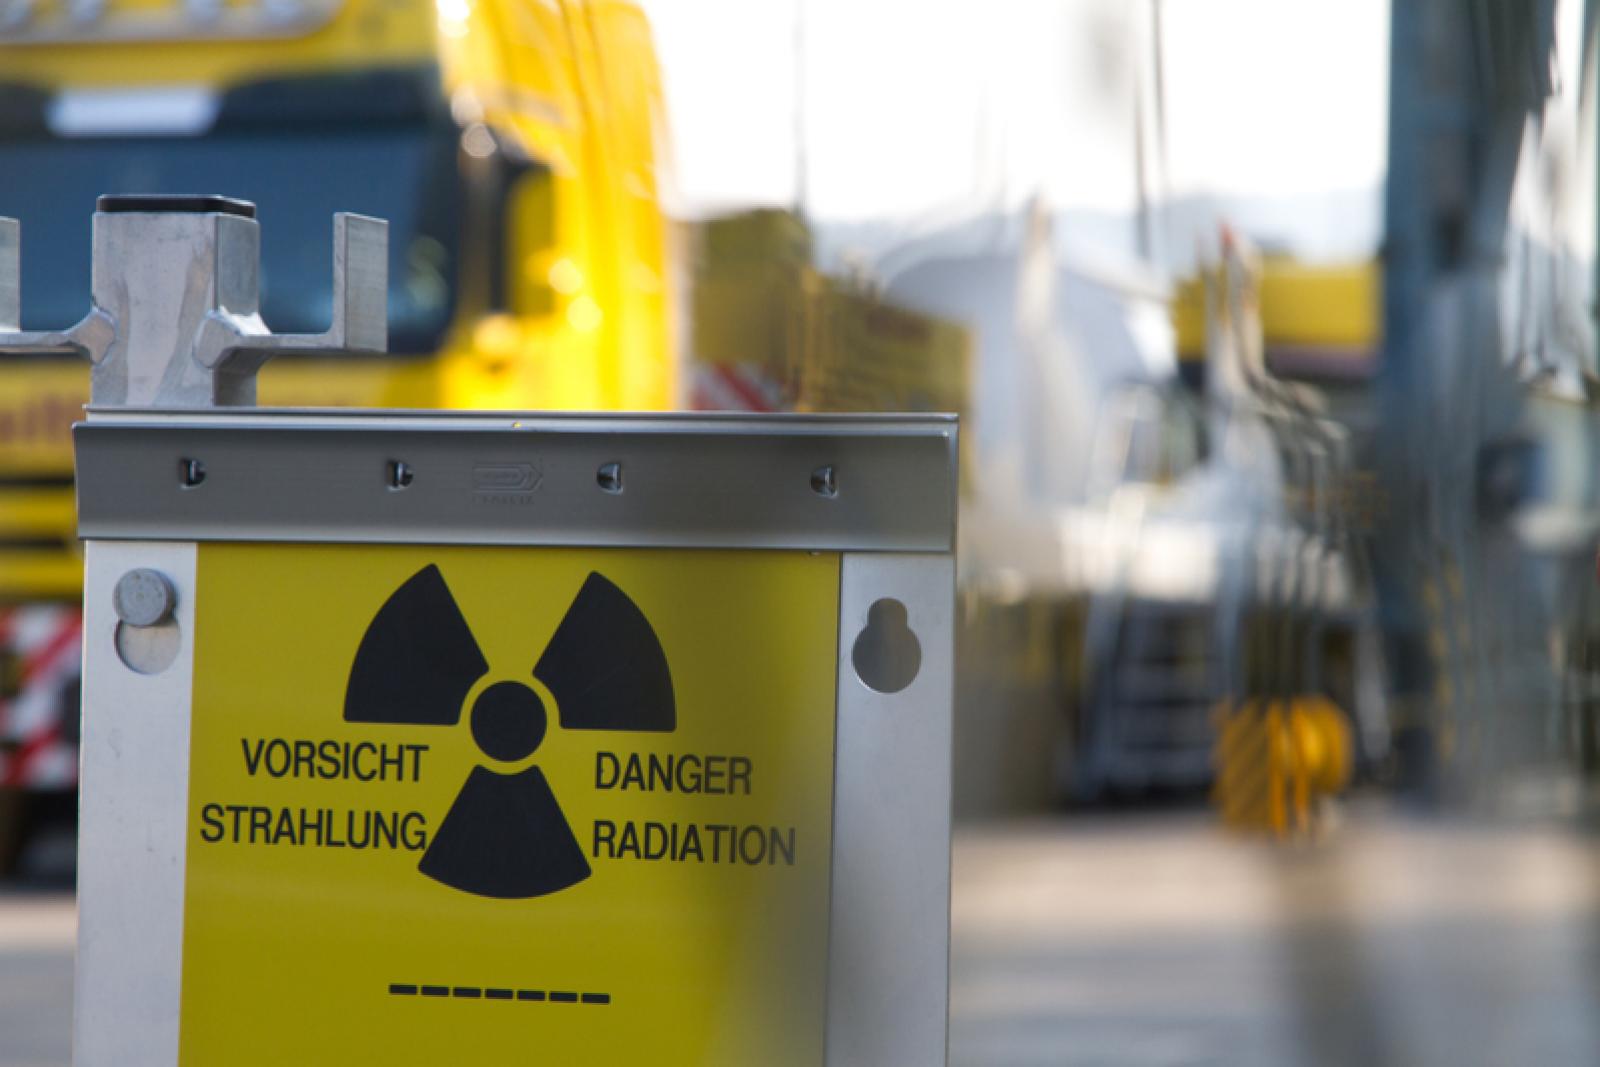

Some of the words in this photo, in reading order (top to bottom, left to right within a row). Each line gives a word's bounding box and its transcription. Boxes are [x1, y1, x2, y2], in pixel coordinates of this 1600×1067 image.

[241, 738, 430, 783] VORSICHT
[595, 751, 752, 796] DANGER
[200, 803, 427, 851] STRAHLUNG
[593, 819, 795, 866] RADIATION
